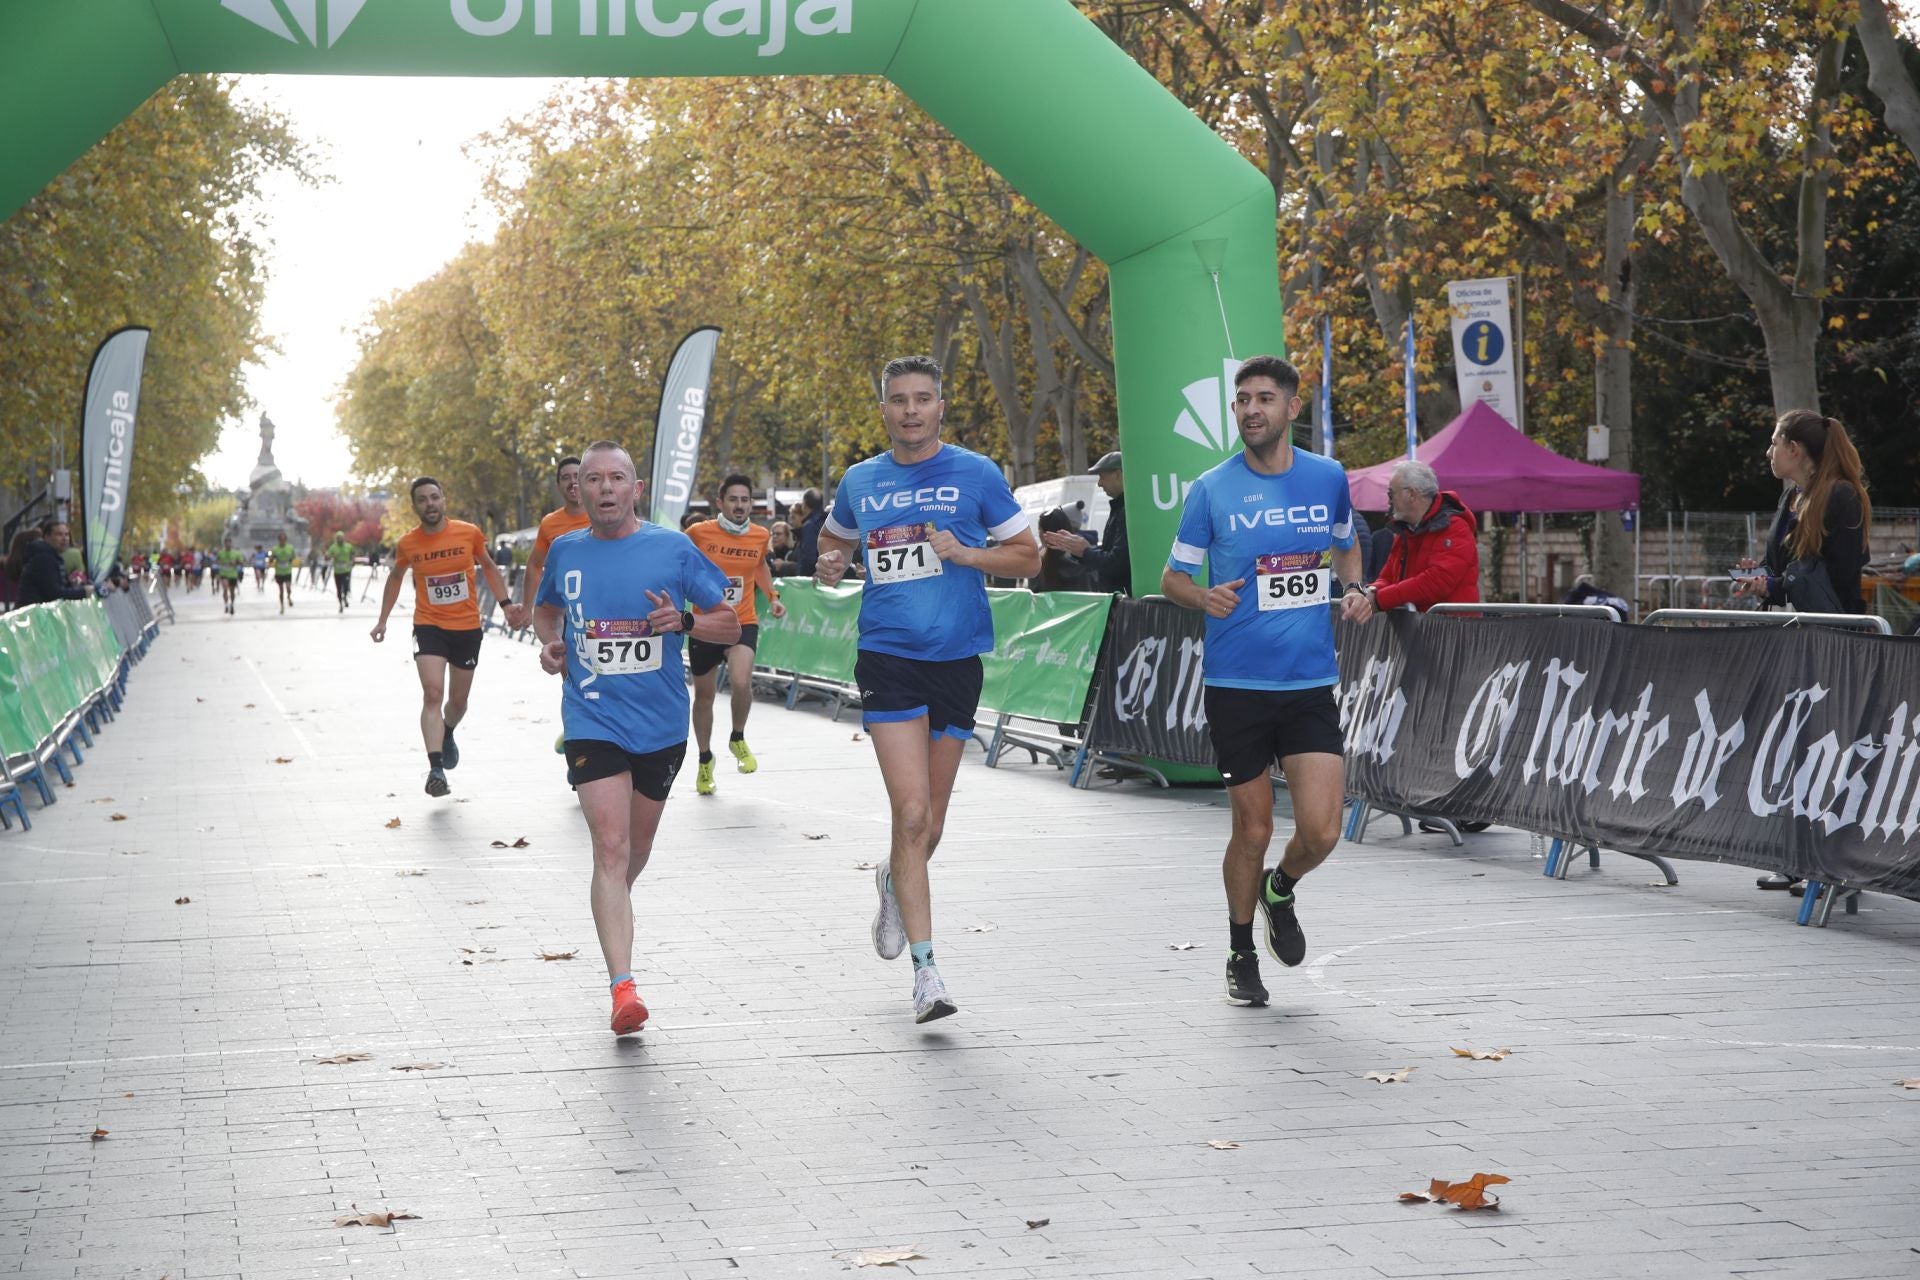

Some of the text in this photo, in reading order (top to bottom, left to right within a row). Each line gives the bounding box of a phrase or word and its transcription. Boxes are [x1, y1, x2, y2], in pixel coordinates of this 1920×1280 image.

[101, 390, 134, 511] Unicaja
[664, 387, 704, 503] Unicaja
[861, 487, 959, 512] IVECO
[920, 503, 957, 514] running
[1229, 504, 1328, 532] IVECO
[1297, 524, 1329, 534] running
[424, 547, 465, 560] LIFETEC
[720, 546, 758, 558] LIFETEC
[877, 545, 925, 573] 571
[434, 585, 461, 599] 993
[1269, 573, 1319, 599] 569
[597, 640, 651, 663] 570
[1454, 658, 1531, 780] El
[1522, 657, 1670, 805] Norte
[1669, 688, 1746, 811] de
